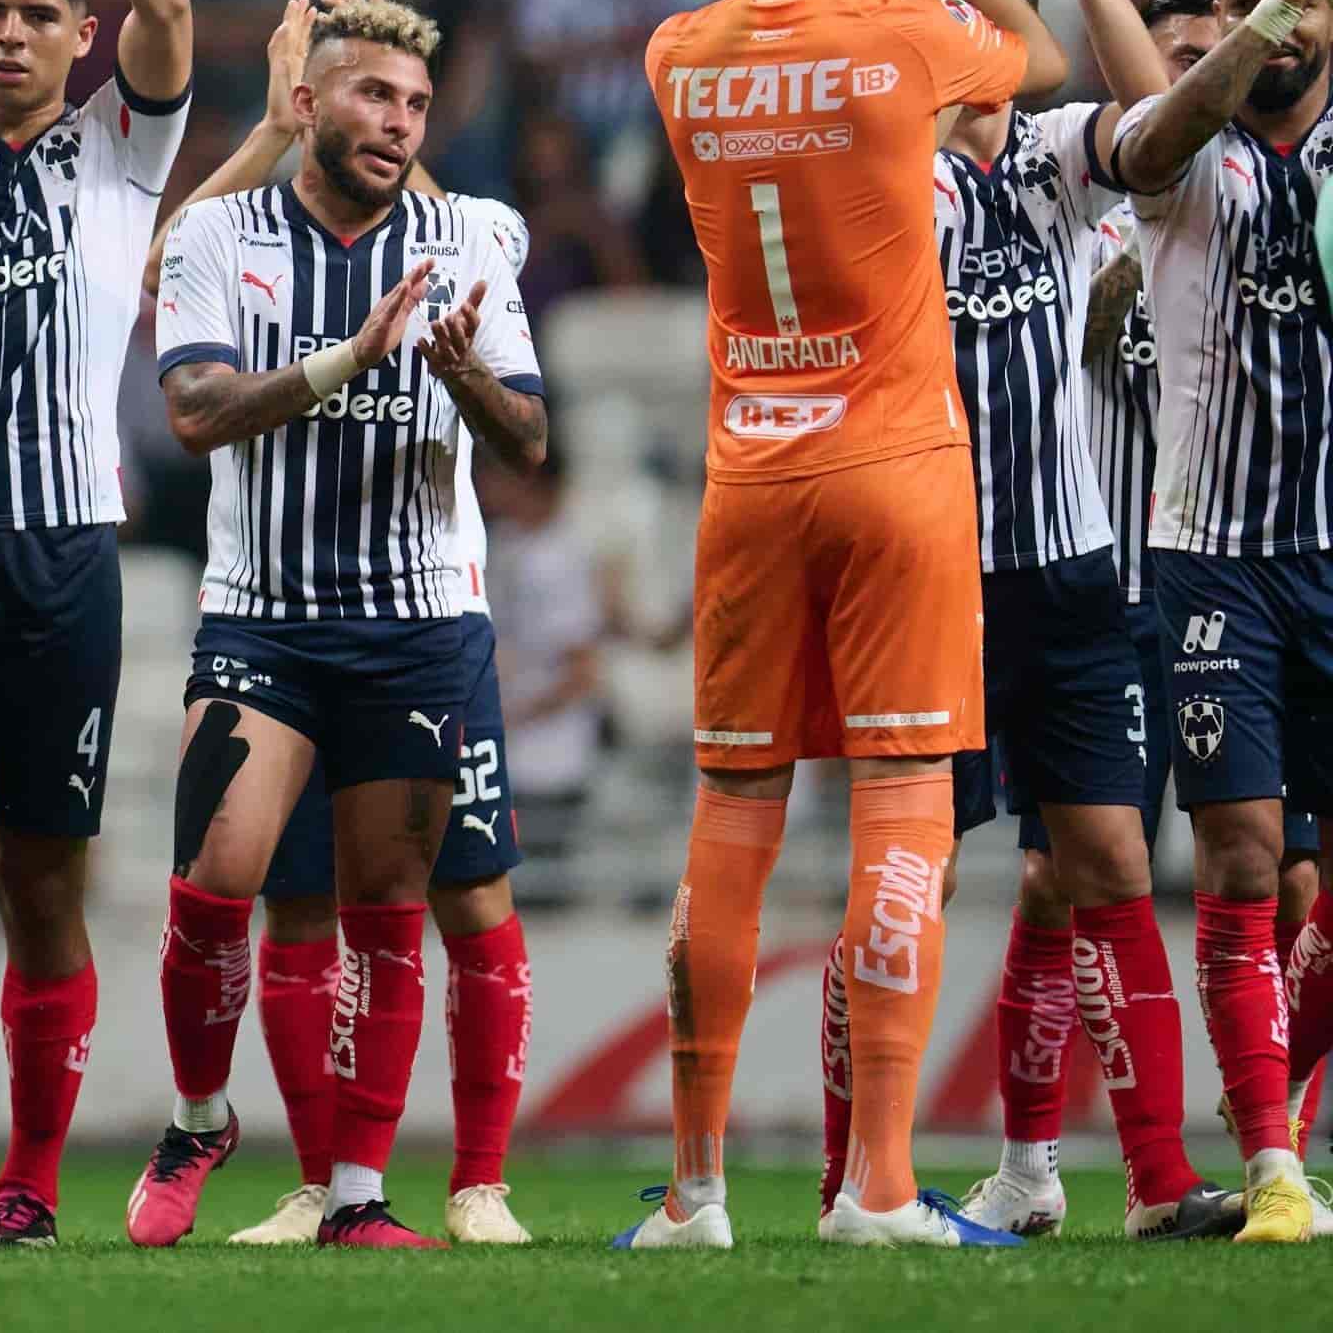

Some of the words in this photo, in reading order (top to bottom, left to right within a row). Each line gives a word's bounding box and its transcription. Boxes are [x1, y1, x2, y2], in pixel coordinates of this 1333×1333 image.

[667, 57, 851, 119] TECATE
[856, 65, 897, 95] 18+
[749, 182, 803, 337] 1
[725, 333, 861, 372] ANDRADA
[1172, 655, 1240, 675] nowports
[76, 706, 103, 768] 4
[853, 848, 931, 995] Escudo
[1071, 937, 1137, 1092] Escudo
